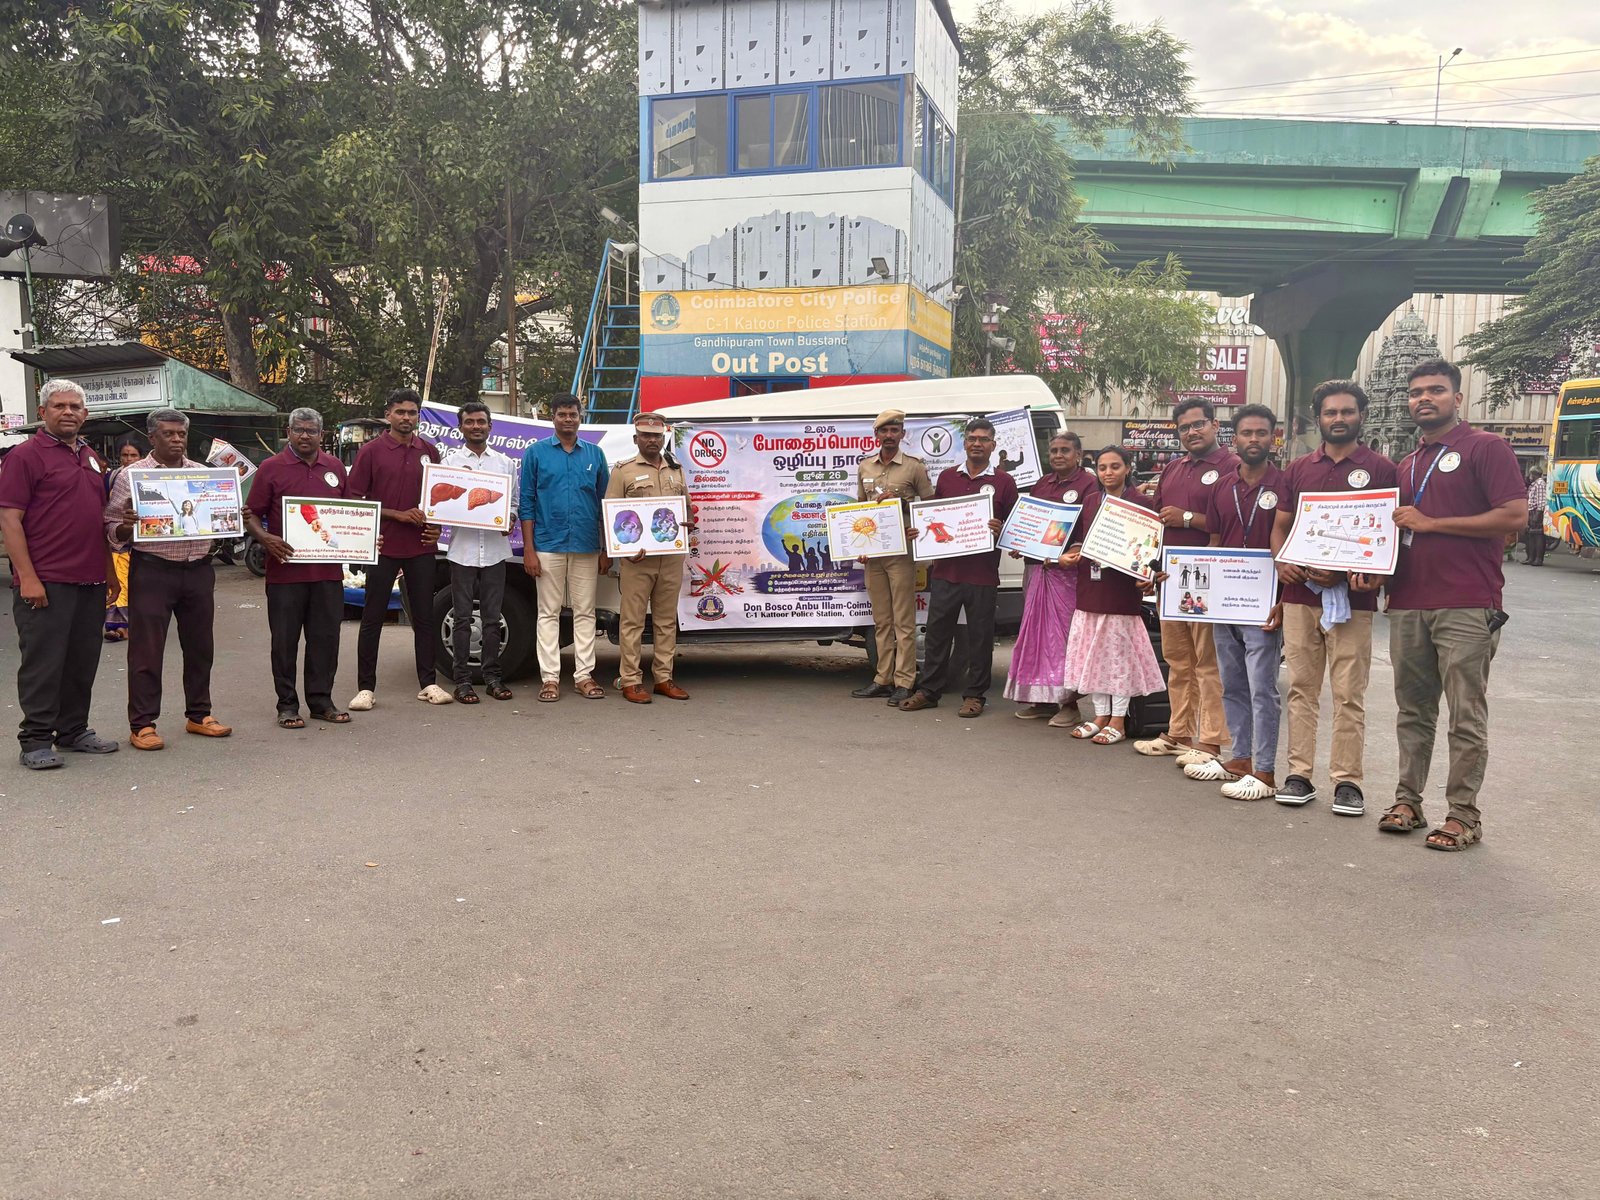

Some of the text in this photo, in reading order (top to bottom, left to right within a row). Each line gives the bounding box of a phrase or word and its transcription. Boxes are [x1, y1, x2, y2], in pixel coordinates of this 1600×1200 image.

[690, 290, 900, 310] Coimbatore City Police
[705, 313, 888, 330] C-1 Katoor Police Station
[694, 334, 848, 351] Gandhipuram Town Busstand
[711, 351, 829, 374] Out Post
[1205, 347, 1247, 371] SALE
[1202, 373, 1217, 381] ON
[804, 425, 836, 434] உலக
[1128, 430, 1175, 442] Vedhalaya
[701, 438, 715, 448] NO
[694, 448, 723, 458] DRUGS
[773, 452, 827, 472] ஒழிப்பு
[828, 471, 841, 479] 26
[743, 601, 873, 612] Don Bosco Anbu Illam-Coimb
[745, 609, 873, 619] C-1 Kattoor Police Station, Coimb
